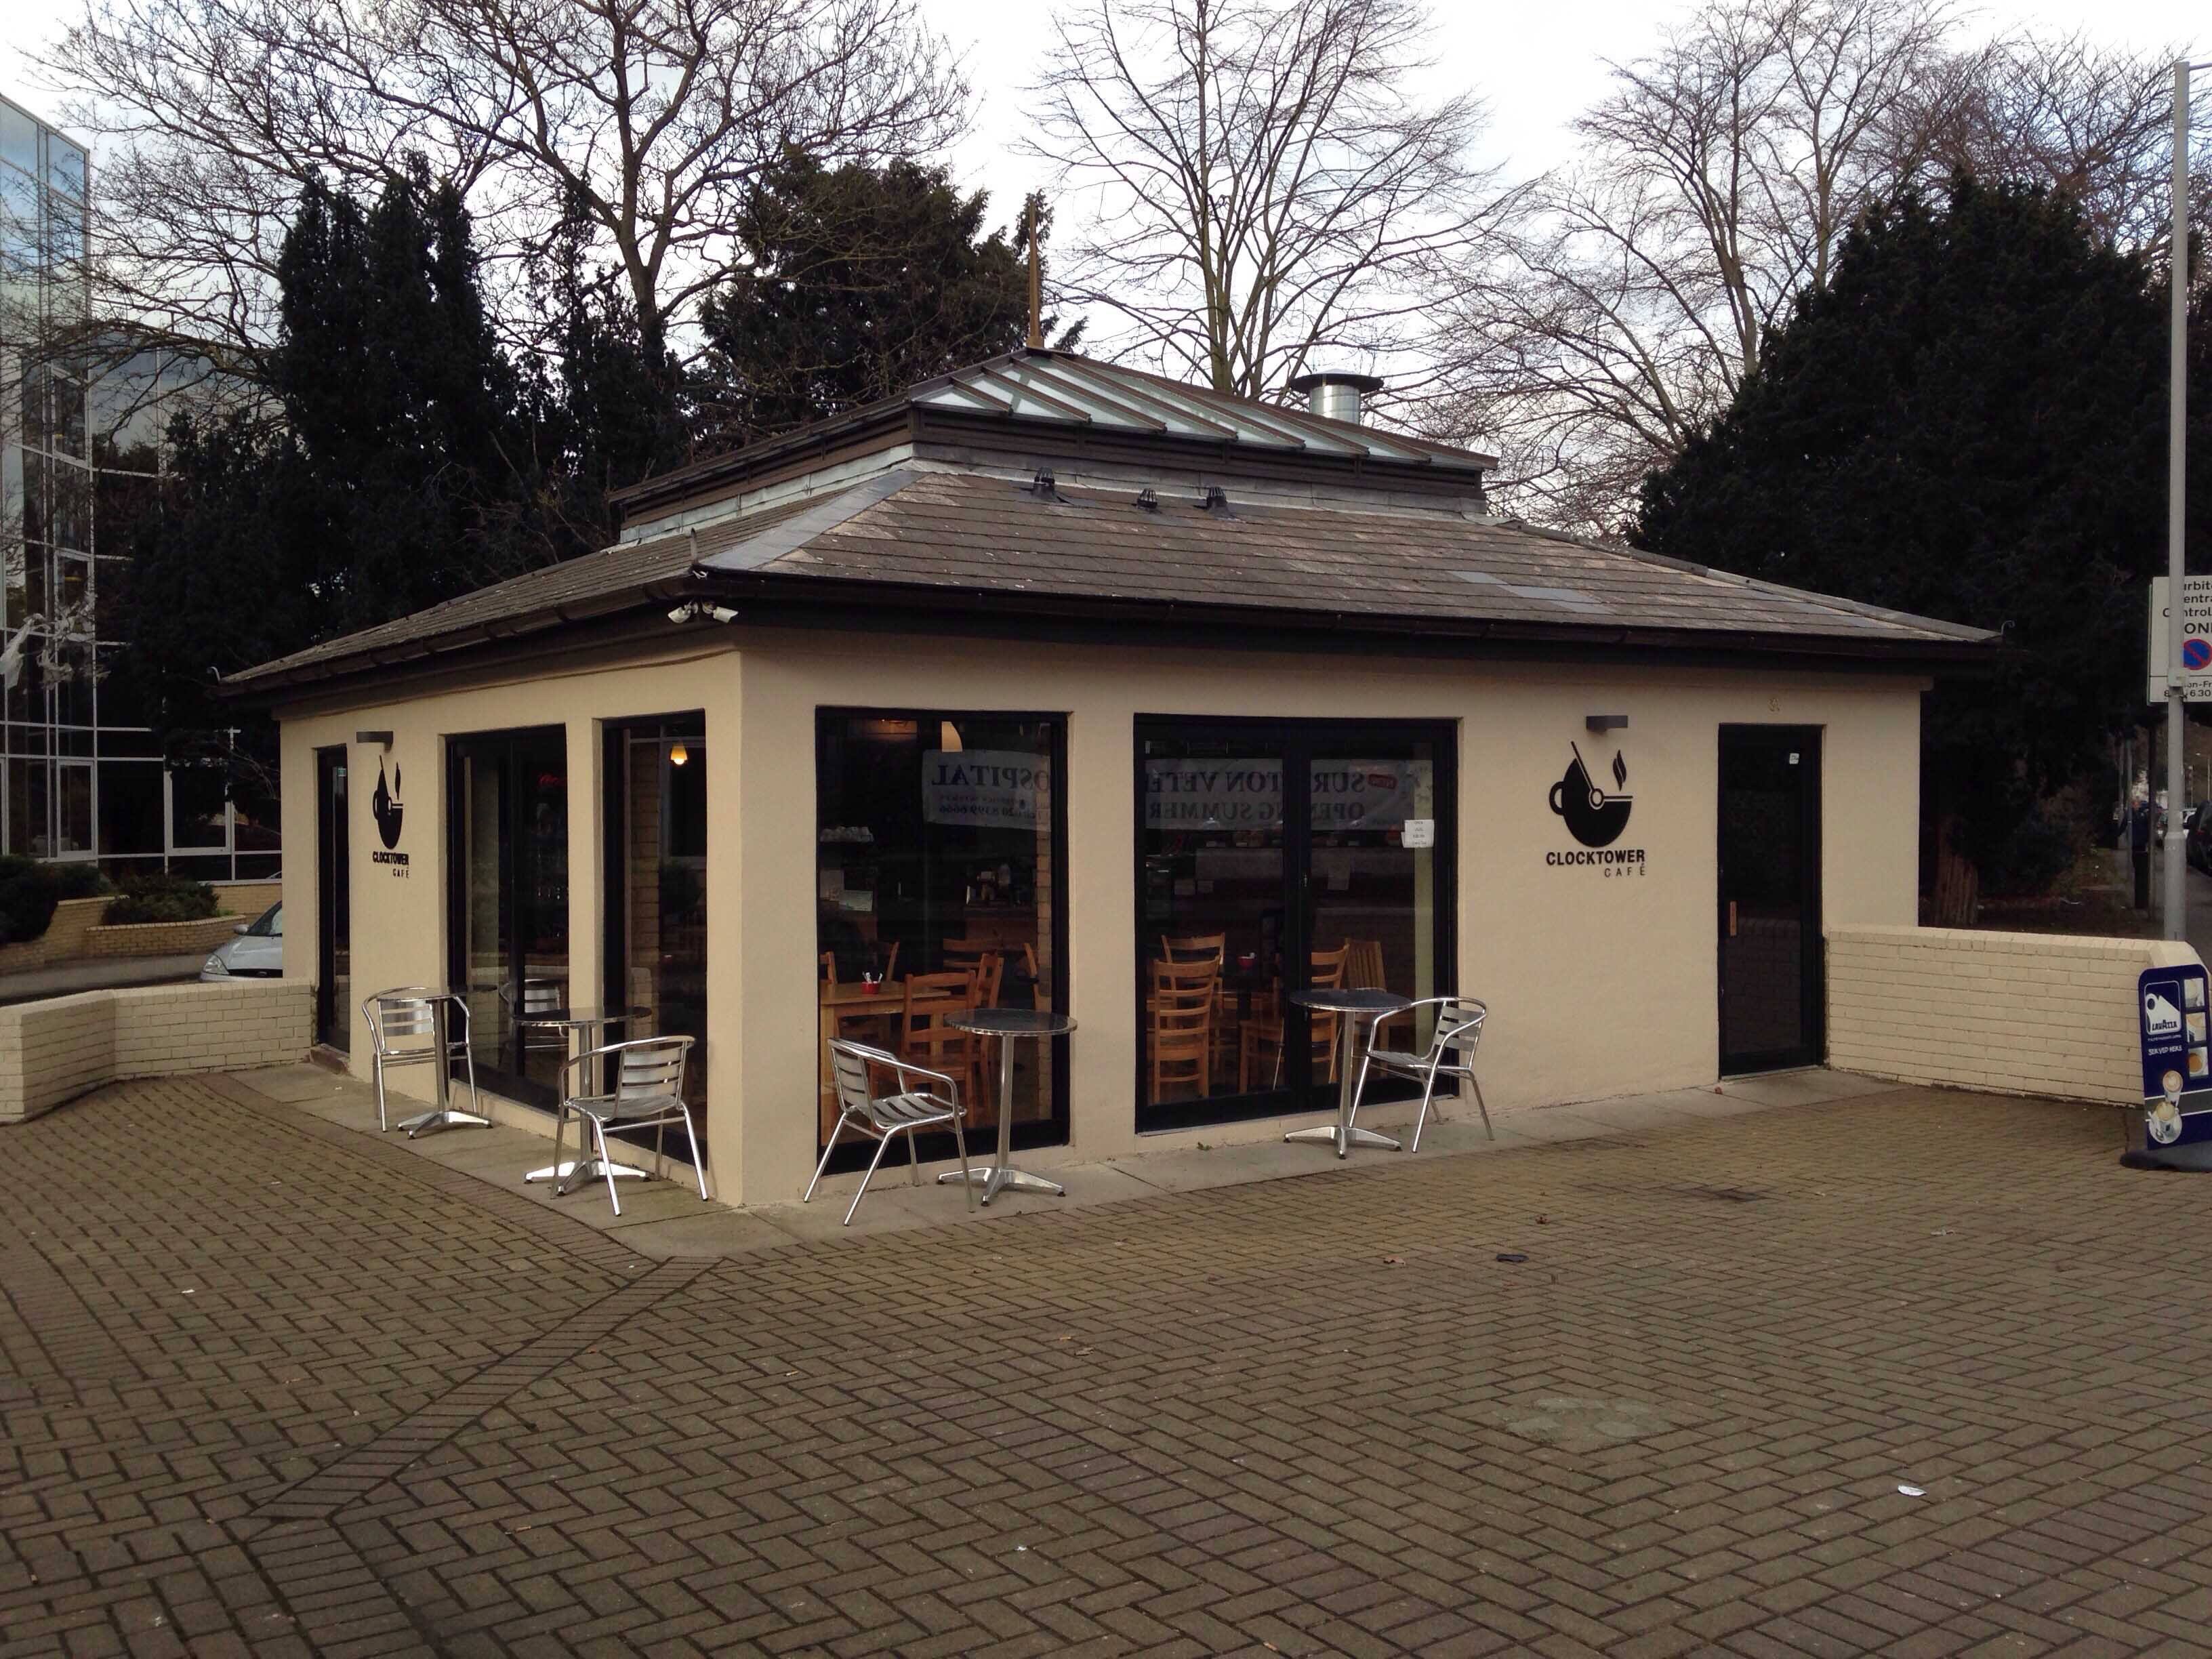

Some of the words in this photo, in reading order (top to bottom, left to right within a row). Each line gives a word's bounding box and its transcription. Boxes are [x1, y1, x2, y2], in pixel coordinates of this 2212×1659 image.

[2184, 594, 2212, 603] entr
[372, 851, 409, 866] CLOCKTOWER
[1546, 848, 1645, 866] CLOCKTOWER
[1604, 863, 1646, 878] CAFÉ
